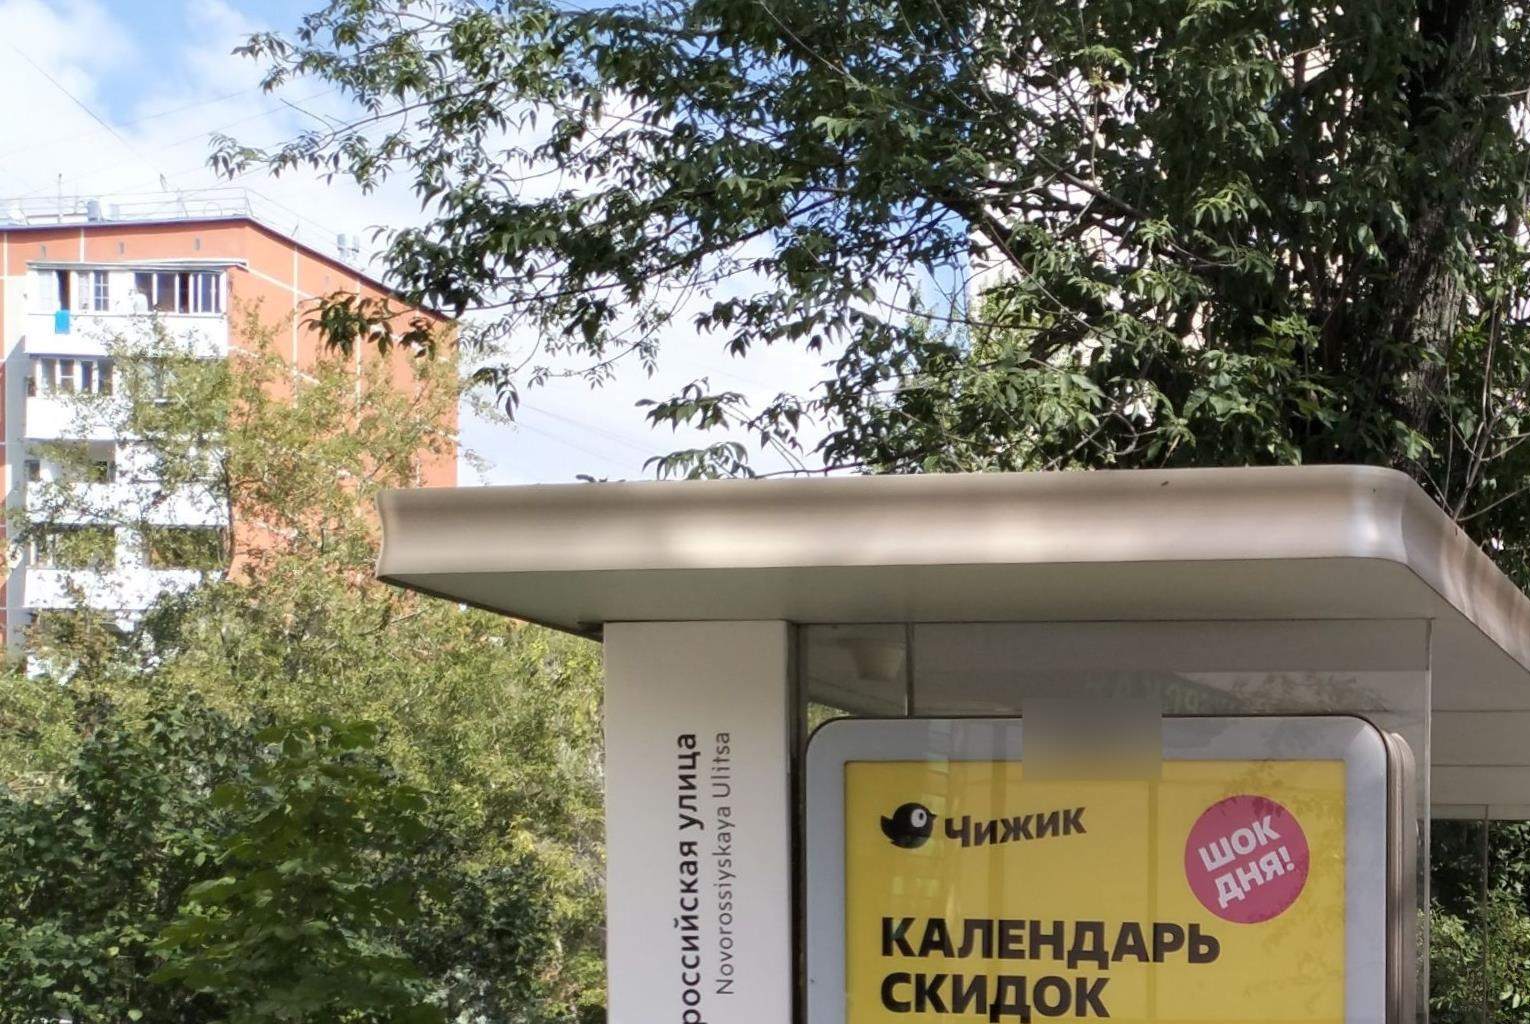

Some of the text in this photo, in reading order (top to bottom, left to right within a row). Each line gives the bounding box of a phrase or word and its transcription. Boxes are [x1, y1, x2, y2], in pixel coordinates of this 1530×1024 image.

[677, 734, 704, 830] улица
[944, 806, 1087, 848] Чижик
[1198, 815, 1281, 872] ШОК
[710, 732, 737, 995] Novorossiyskaya Ulitsa
[1214, 846, 1295, 909] ДНЯ!
[881, 916, 1221, 970] КАЛЕНДАРЬ
[880, 972, 1111, 1024] СКИДОК
